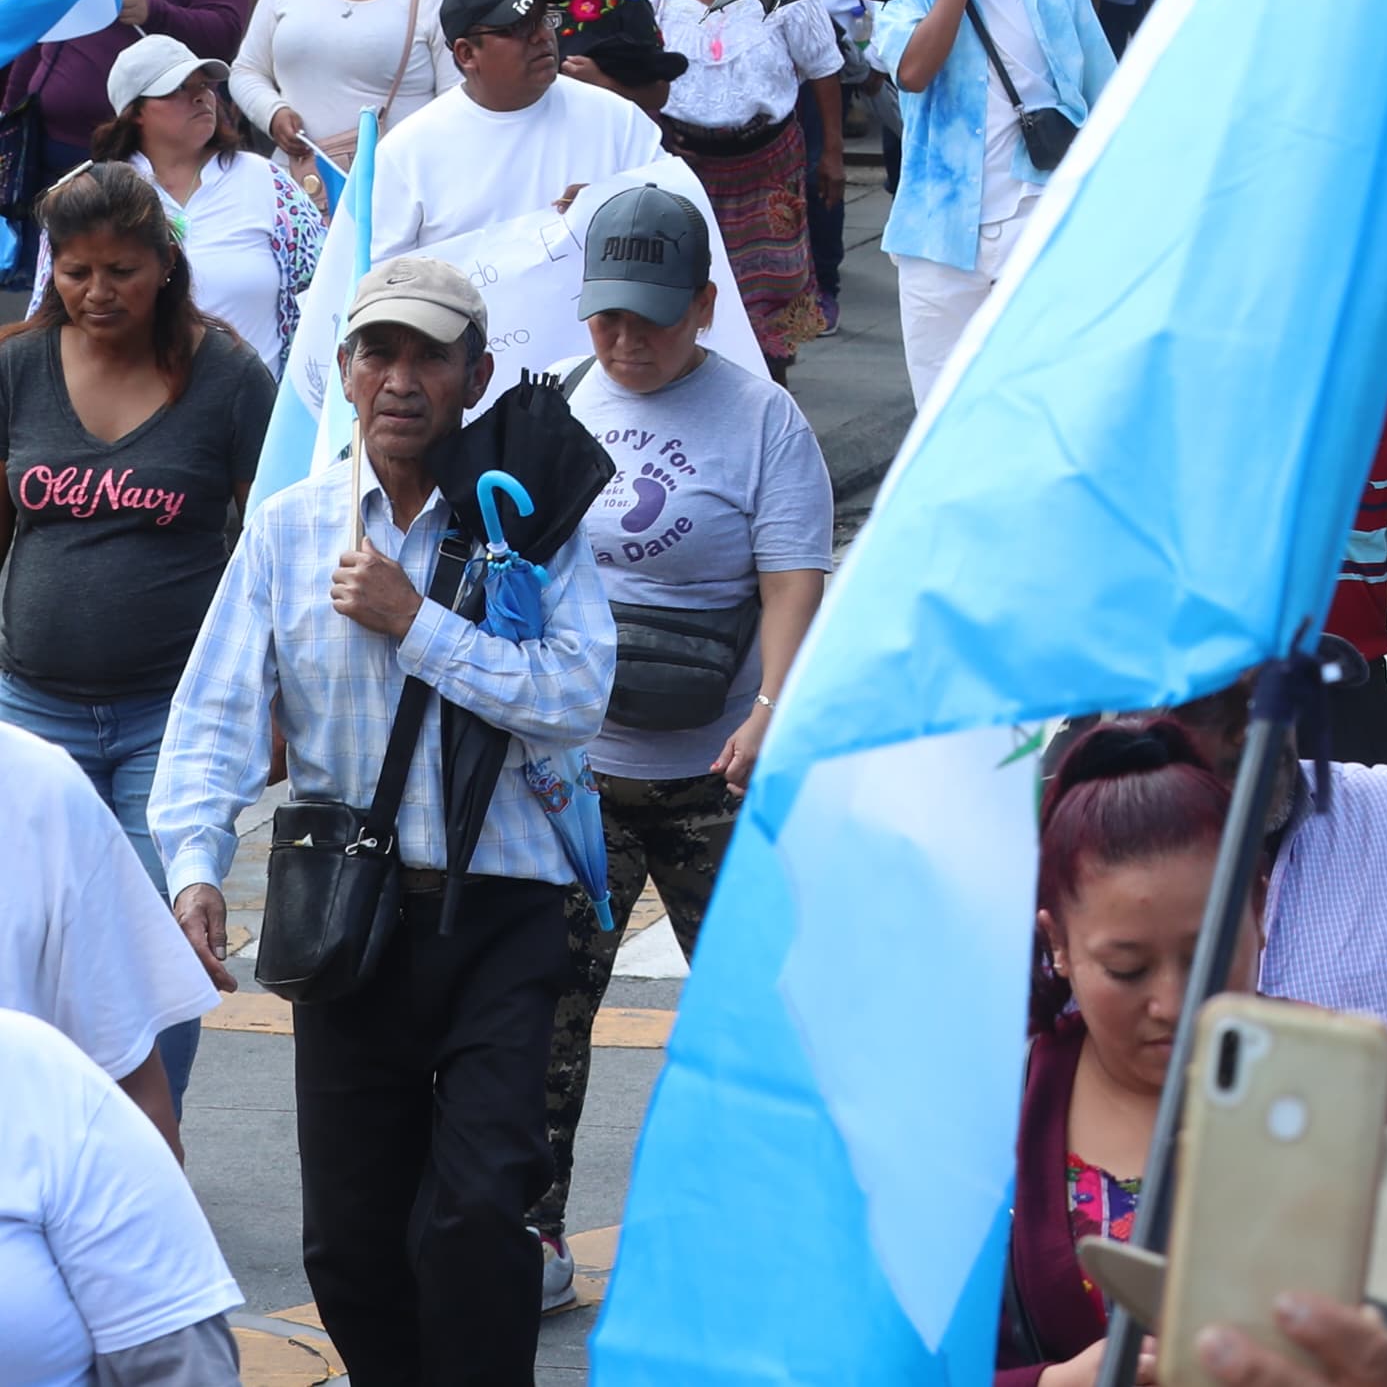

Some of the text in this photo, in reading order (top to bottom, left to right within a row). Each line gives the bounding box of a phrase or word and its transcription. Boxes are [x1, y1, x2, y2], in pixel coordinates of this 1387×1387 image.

[601, 235, 665, 264] PUMA
[658, 438, 697, 475] for
[20, 465, 186, 526] Old Navy
[622, 516, 694, 563] Dane
